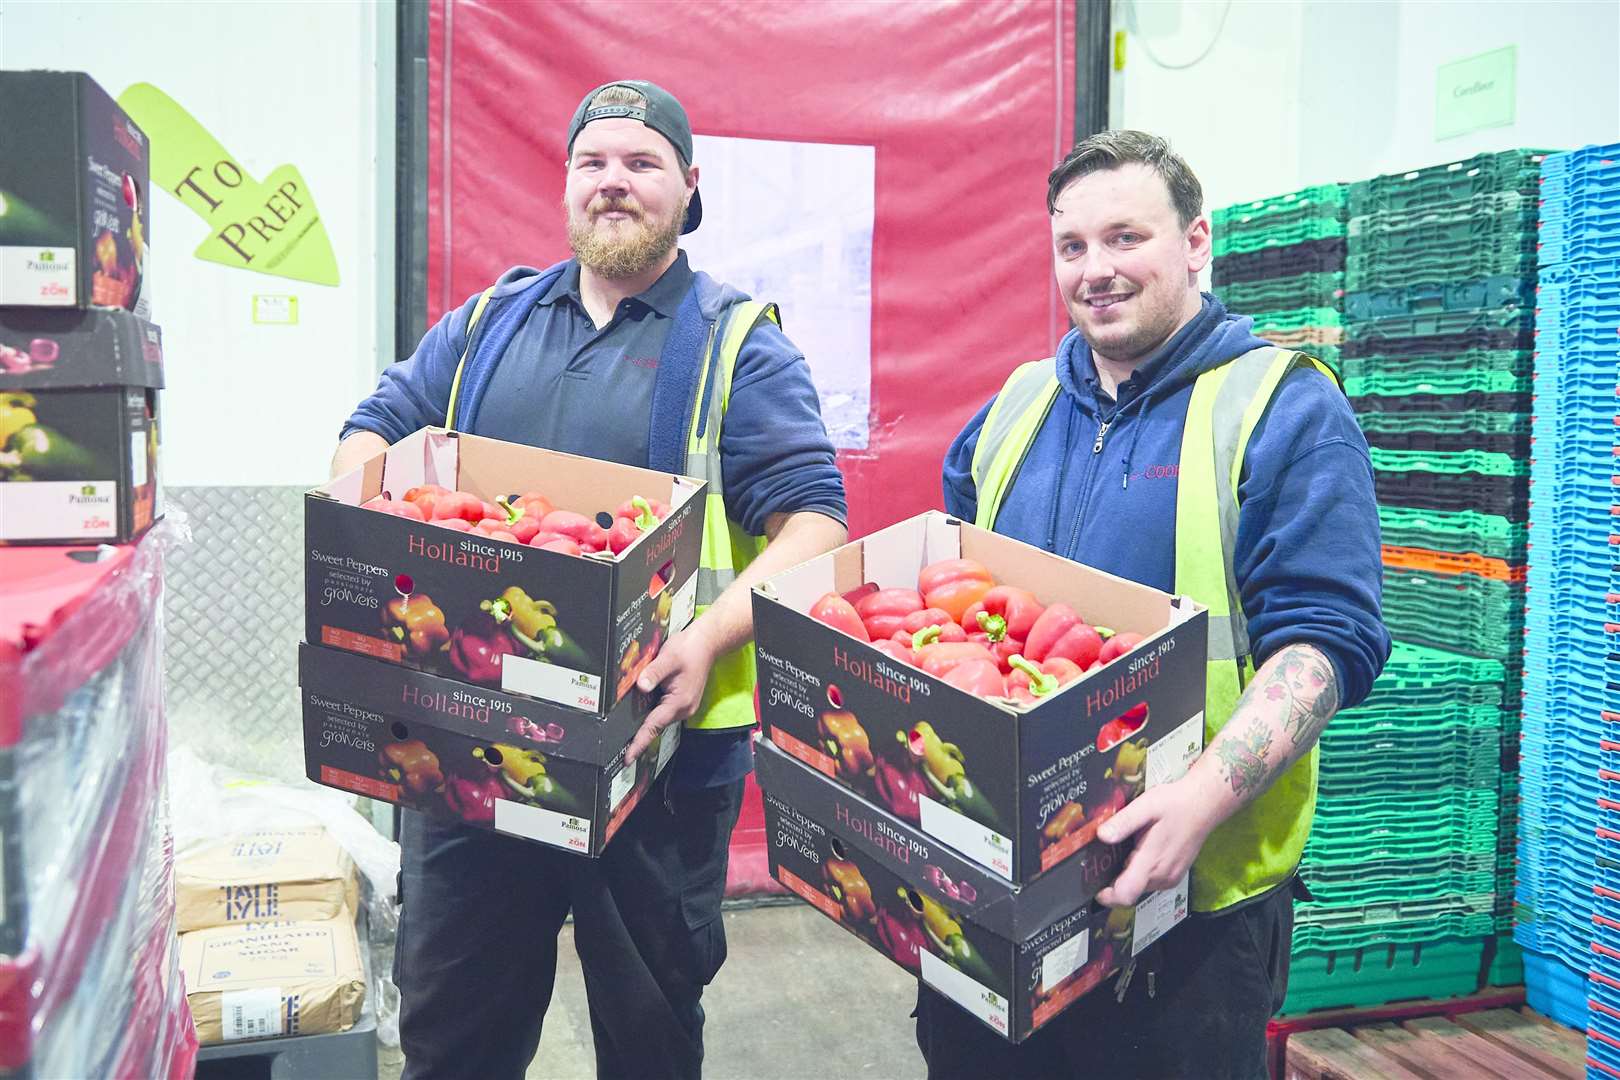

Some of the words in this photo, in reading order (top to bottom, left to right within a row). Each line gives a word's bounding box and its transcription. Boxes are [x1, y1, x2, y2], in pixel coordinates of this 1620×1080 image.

[311, 549, 344, 567] Sweet
[346, 557, 390, 577] Peppers
[408, 534, 500, 574] Holland
[459, 539, 496, 556] since
[499, 548, 524, 562] 1915
[328, 570, 360, 584] selected
[360, 578, 372, 588] by
[759, 647, 785, 669] Sweet
[785, 660, 821, 687] Peppers
[1127, 652, 1157, 675] since
[1156, 636, 1177, 656] 1915
[773, 671, 798, 688] selected
[798, 683, 808, 694] by
[834, 647, 911, 704] Holland
[875, 660, 907, 685] since
[909, 677, 932, 697] 1915
[1085, 656, 1161, 717] Holland
[310, 694, 342, 712] Sweet
[343, 703, 385, 723] Peppers
[402, 684, 491, 724] Holland
[452, 689, 487, 706] since
[490, 699, 513, 714] 1915
[327, 715, 357, 728] selected
[357, 723, 368, 732] by
[1027, 763, 1058, 788] Sweet
[1057, 742, 1096, 770] Peppers
[780, 816, 804, 835] selected
[804, 830, 813, 841] by
[791, 807, 826, 836] Peppers
[835, 802, 911, 865] Holland
[876, 820, 907, 846] since
[908, 839, 930, 860] 1915
[1049, 906, 1088, 936] Peppers
